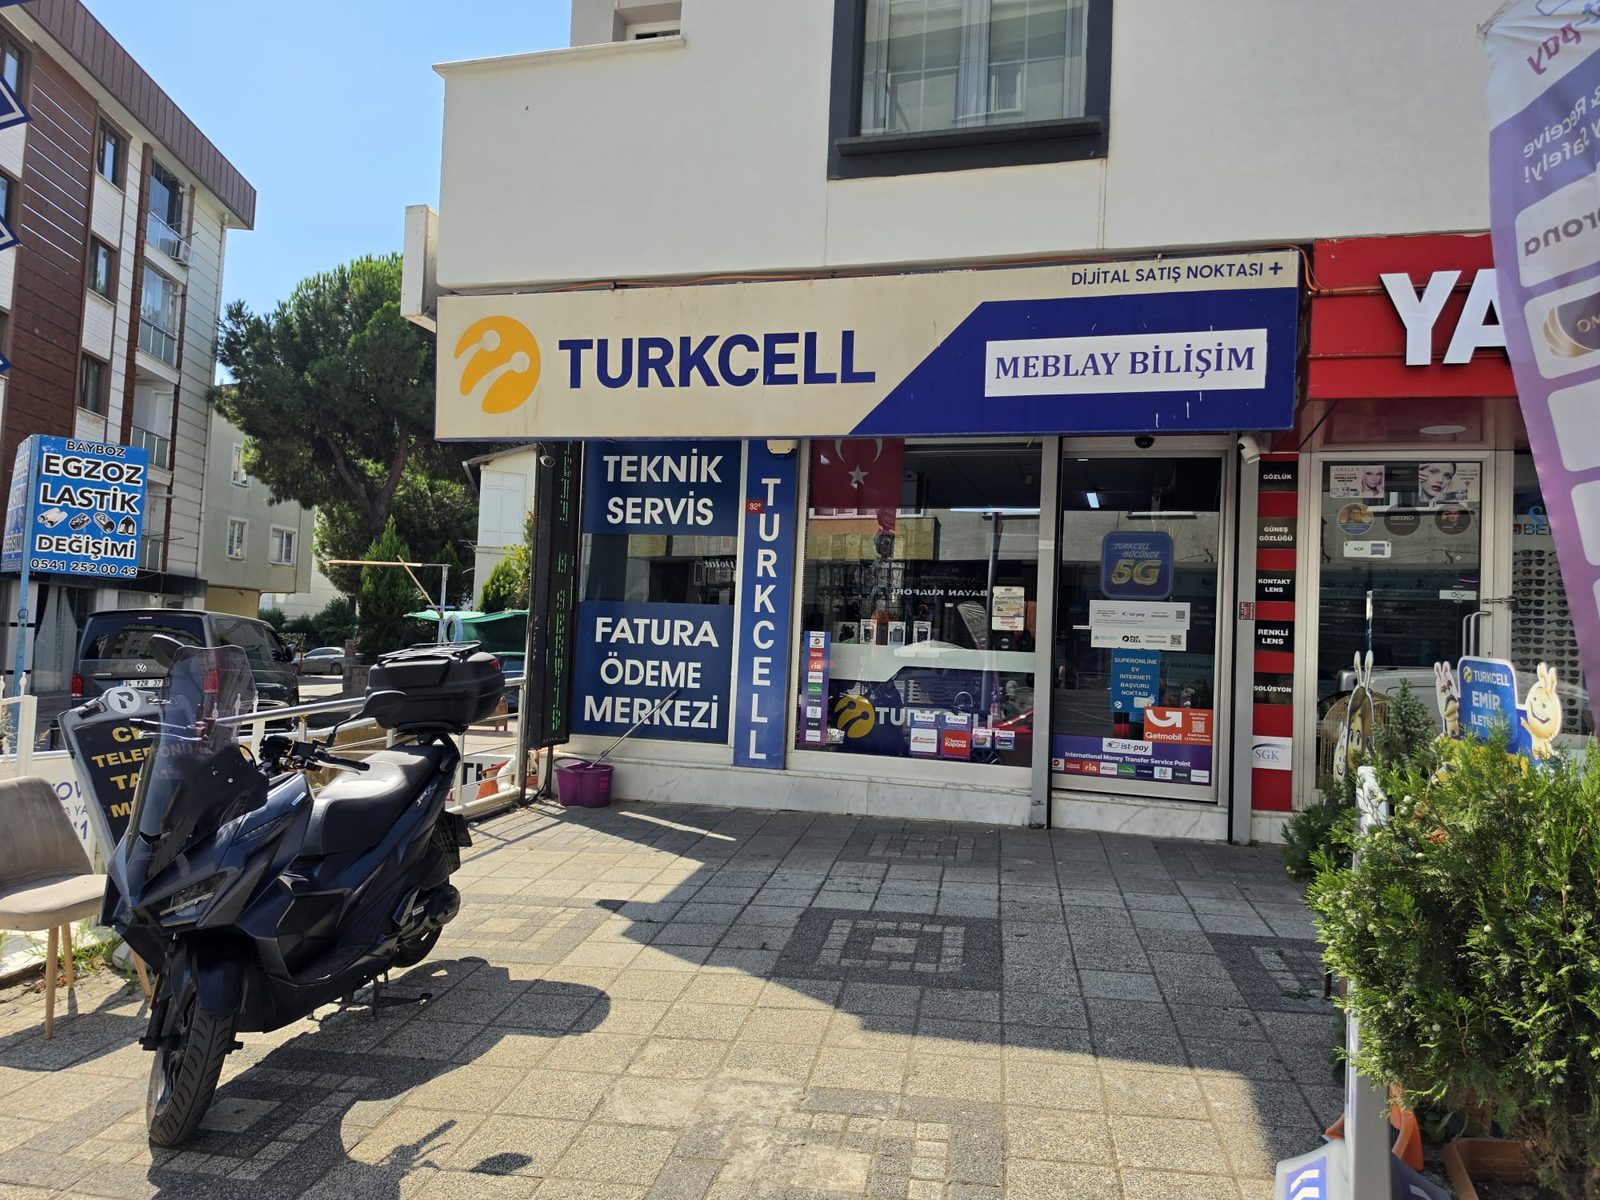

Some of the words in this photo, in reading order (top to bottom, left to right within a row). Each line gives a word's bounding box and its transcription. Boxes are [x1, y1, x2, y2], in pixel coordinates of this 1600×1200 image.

[1071, 268, 1130, 286] DİJİTAL
[1136, 266, 1182, 284] SATIŞ
[1186, 262, 1264, 280] NOKTASI
[558, 329, 876, 389] TURKCELL
[995, 352, 1121, 380] MEBLAY
[1129, 342, 1255, 379] BİLİŞİM
[66, 440, 126, 458] BAYBOZ
[43, 454, 144, 485] EGZOZ
[603, 448, 723, 483] TEKNİK
[1263, 472, 1293, 480] GÖZLÜK
[40, 483, 141, 514] LASTİK
[607, 490, 713, 526] SERVİS
[36, 535, 137, 560] DEĞİŞİMİ
[30, 558, 66, 571] 0541
[71, 561, 97, 573] 252
[100, 564, 117, 576] 00
[120, 566, 137, 576] 43
[1111, 559, 1162, 586] 5G
[748, 477, 782, 760] TURKCELL
[595, 617, 719, 648] FATURA
[600, 651, 702, 689] ÖDEME
[1473, 670, 1510, 687] TURKCELL
[584, 694, 718, 729] MERKEZİ
[1472, 690, 1500, 710] EMİR
[1120, 742, 1149, 752] ist-pay
[1145, 731, 1182, 741] Getmobil
[1065, 751, 1102, 760] International
[1103, 754, 1123, 763] Money
[1125, 756, 1150, 764] Transfer
[1151, 758, 1173, 766] Service
[1254, 750, 1280, 761] SGK
